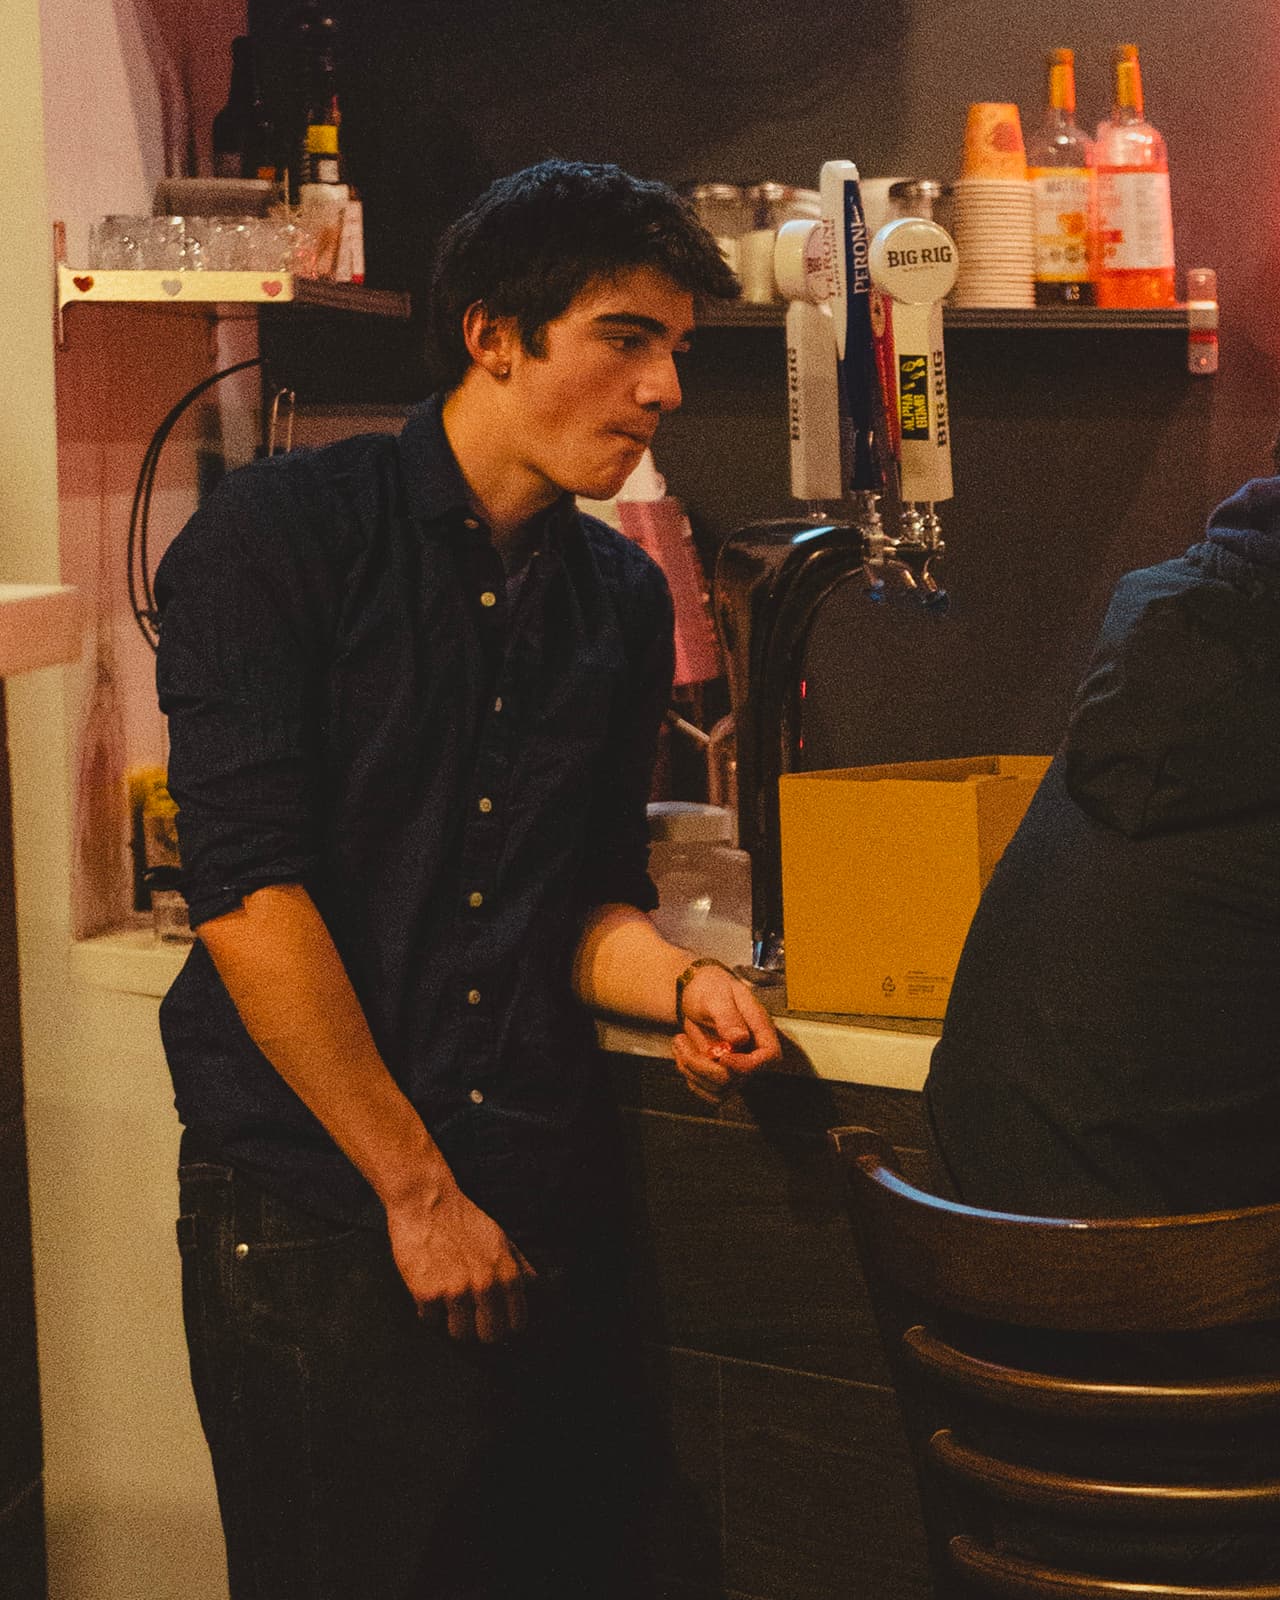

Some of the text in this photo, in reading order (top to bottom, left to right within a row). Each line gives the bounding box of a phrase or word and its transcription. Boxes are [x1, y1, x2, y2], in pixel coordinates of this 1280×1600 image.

[851, 221, 870, 295] PERONI
[887, 245, 953, 268] BIG RIG
[901, 393, 915, 432] ALPHA
[932, 350, 948, 448] BIG RIG
